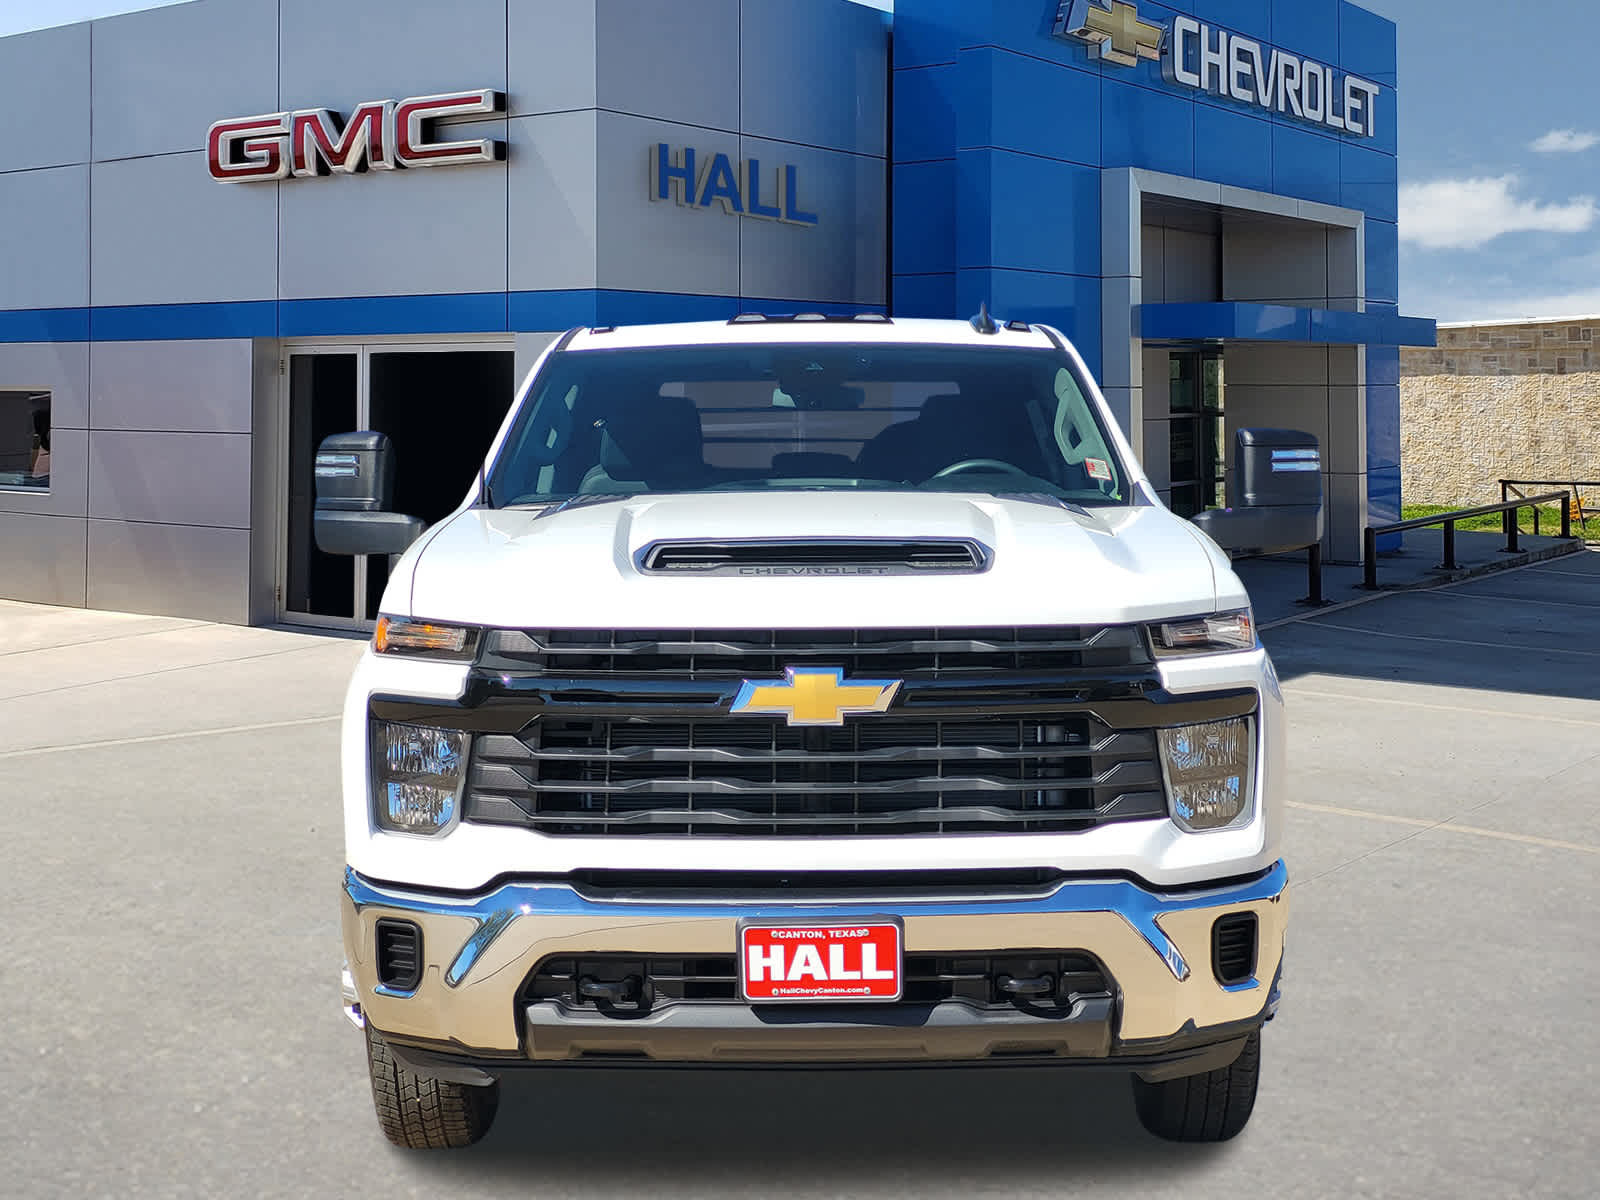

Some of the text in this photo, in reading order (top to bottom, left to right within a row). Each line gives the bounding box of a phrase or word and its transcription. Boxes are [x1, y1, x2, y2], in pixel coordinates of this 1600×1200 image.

[1174, 15, 1380, 137] CHEVROLET
[207, 88, 502, 184] GMC
[652, 142, 819, 226] HALL
[738, 567, 889, 575] CHEVROLET
[778, 929, 863, 939] CANTON, TEXAS
[748, 943, 894, 982] HALL
[780, 986, 864, 996] HallChevyCanton.com
